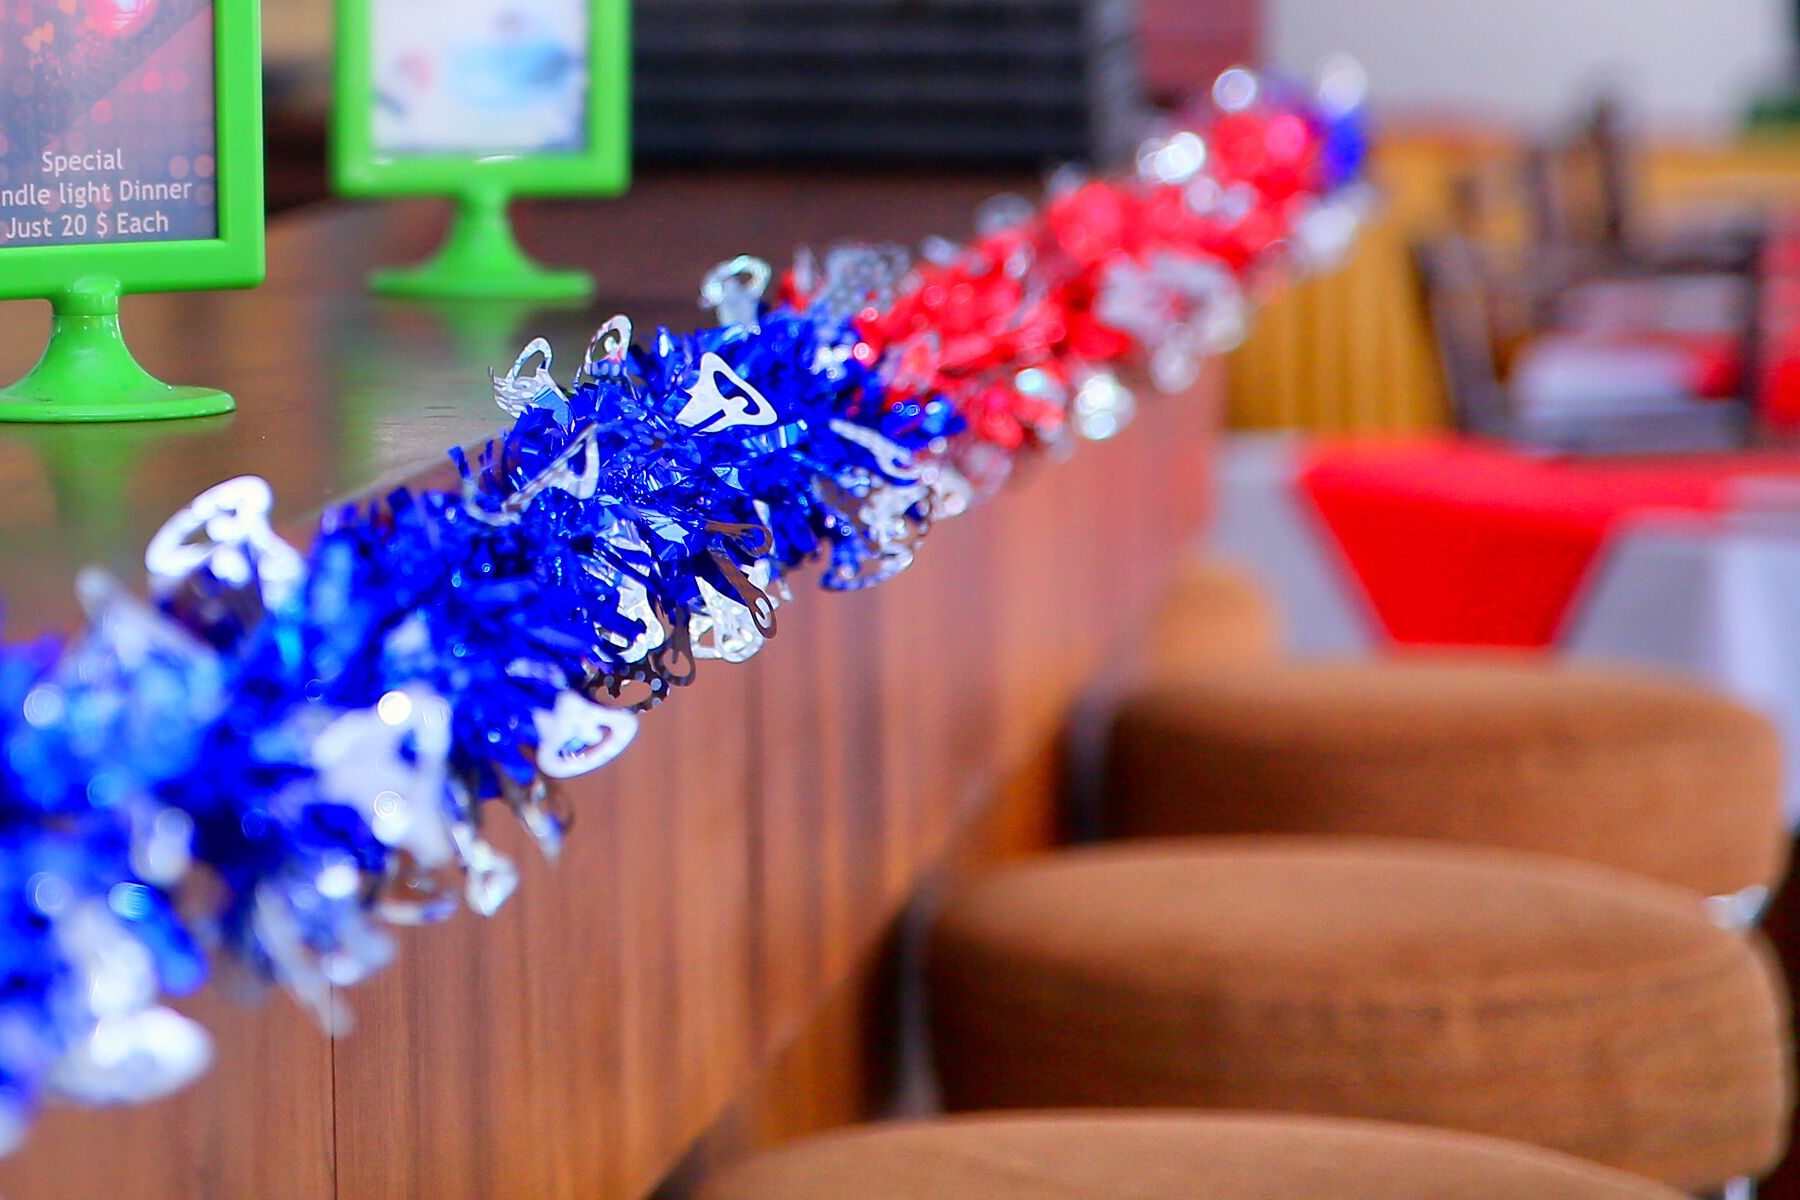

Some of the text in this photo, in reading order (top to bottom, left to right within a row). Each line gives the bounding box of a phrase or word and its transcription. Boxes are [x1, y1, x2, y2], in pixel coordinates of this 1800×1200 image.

[42, 149, 122, 177] Special
[59, 183, 112, 208] light
[119, 179, 192, 202] Dinner
[6, 211, 169, 239] Just 20 $ Each
